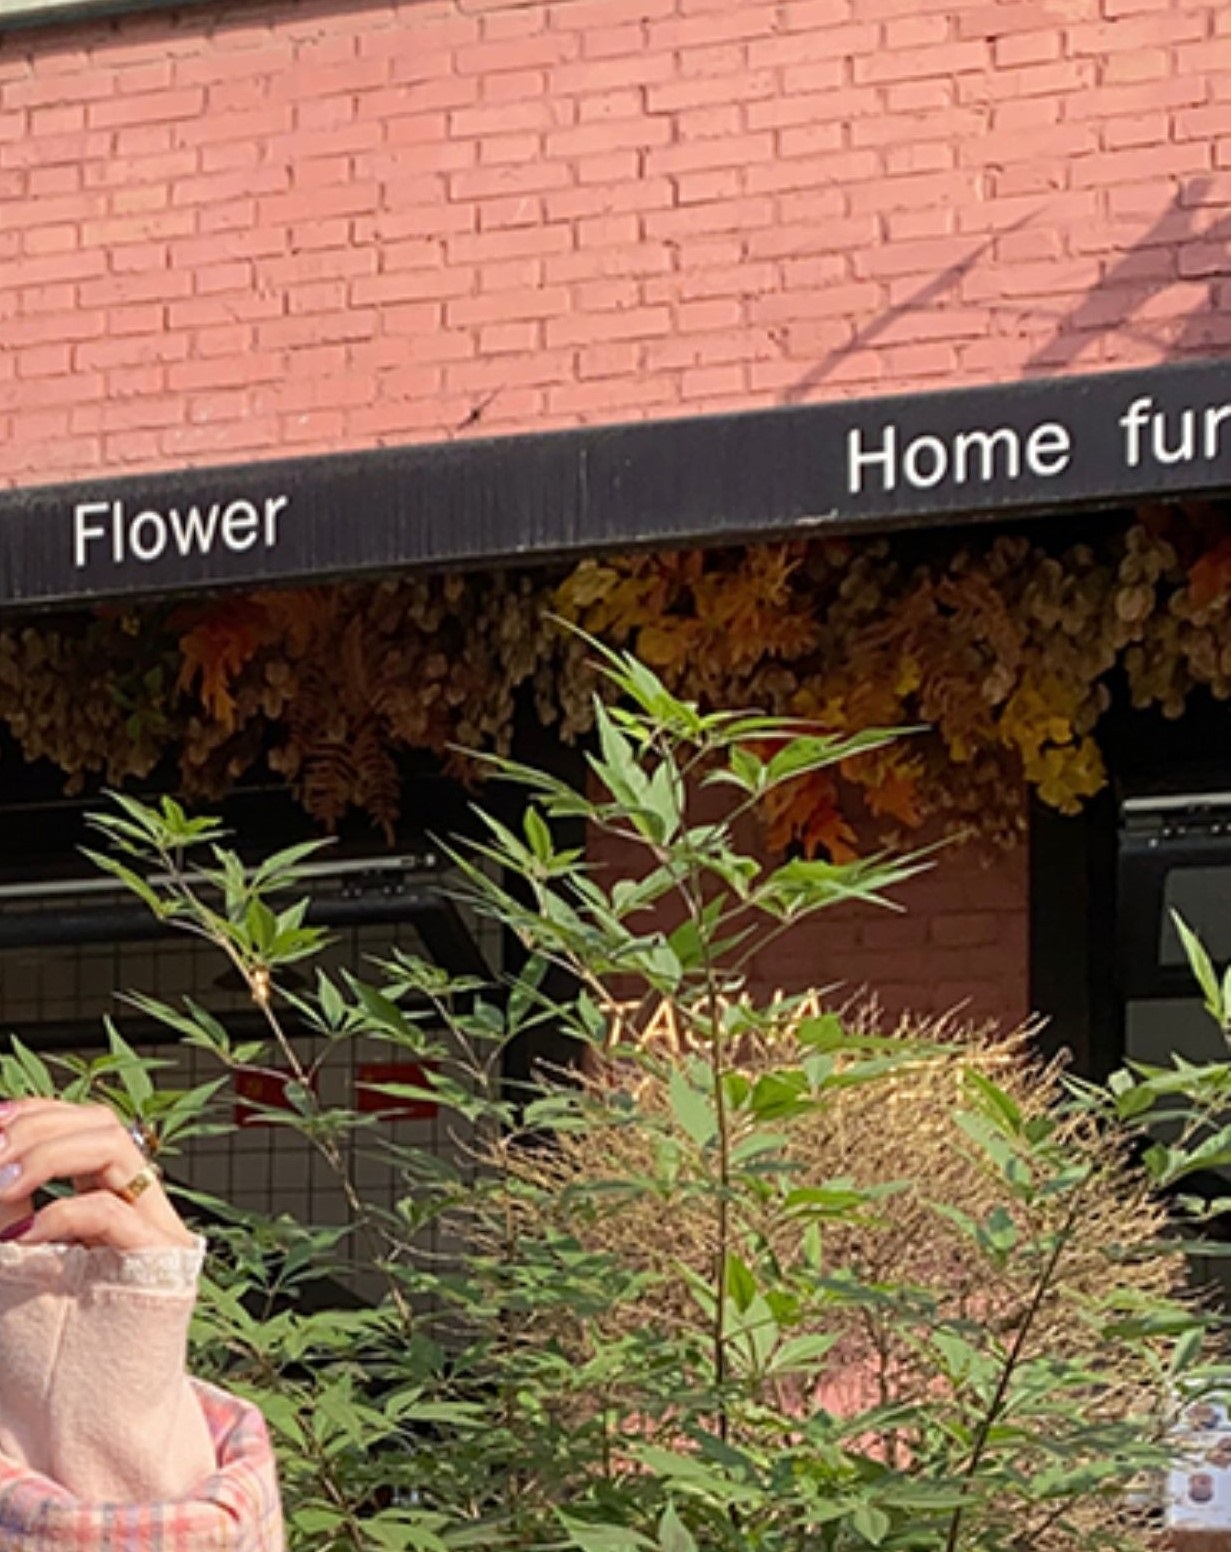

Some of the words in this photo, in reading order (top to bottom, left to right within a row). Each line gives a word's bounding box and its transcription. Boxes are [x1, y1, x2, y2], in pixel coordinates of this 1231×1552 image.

[847, 404, 1071, 494] Home
[1118, 395, 1231, 468] fur
[74, 496, 289, 567] Flower
